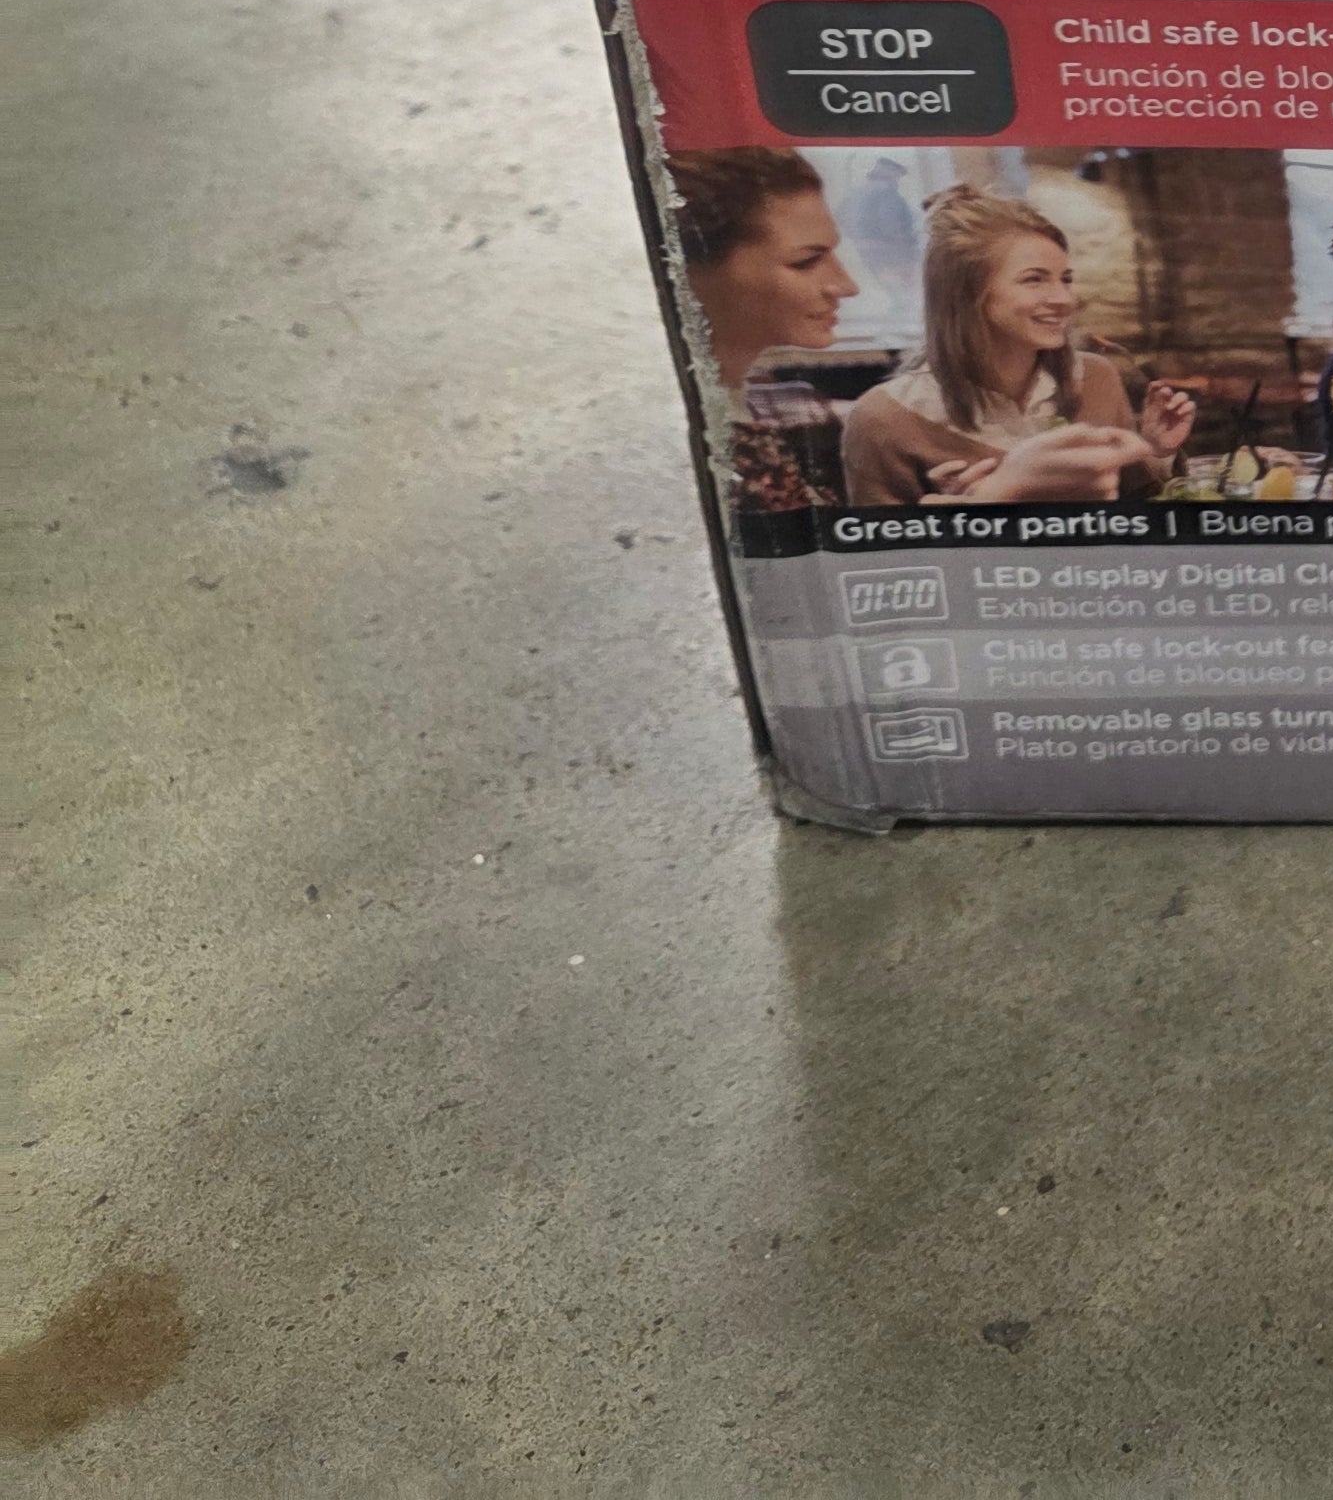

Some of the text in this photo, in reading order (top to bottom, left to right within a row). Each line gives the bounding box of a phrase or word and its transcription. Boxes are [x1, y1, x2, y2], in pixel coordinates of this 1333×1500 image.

[820, 28, 934, 60] STOP
[1053, 17, 1151, 45] Child
[1163, 20, 1240, 47] safe
[1058, 62, 1208, 89] Función
[1219, 64, 1266, 90] de
[820, 83, 952, 114] Cancel
[1063, 93, 1262, 121] protección
[1273, 94, 1319, 120] de
[833, 514, 943, 542] Great
[951, 512, 1008, 538] for
[1018, 510, 1150, 541] parties
[1199, 510, 1314, 537] Buena
[973, 565, 1042, 589] LED
[1052, 563, 1169, 591] display
[1178, 562, 1286, 589] Digital
[978, 596, 1146, 620] Exhibición
[1155, 594, 1196, 616] de
[983, 638, 1068, 661] Child
[1077, 636, 1145, 660] safe
[1153, 634, 1287, 658] lock-out
[987, 664, 1116, 688] Función
[1124, 664, 1166, 686] de
[1175, 663, 1306, 688] bloqueo
[993, 708, 1173, 733] Removable
[1180, 706, 1264, 733] glass
[996, 736, 1078, 759] Plato
[1086, 734, 1221, 761] giratorio
[1230, 733, 1270, 756] de
